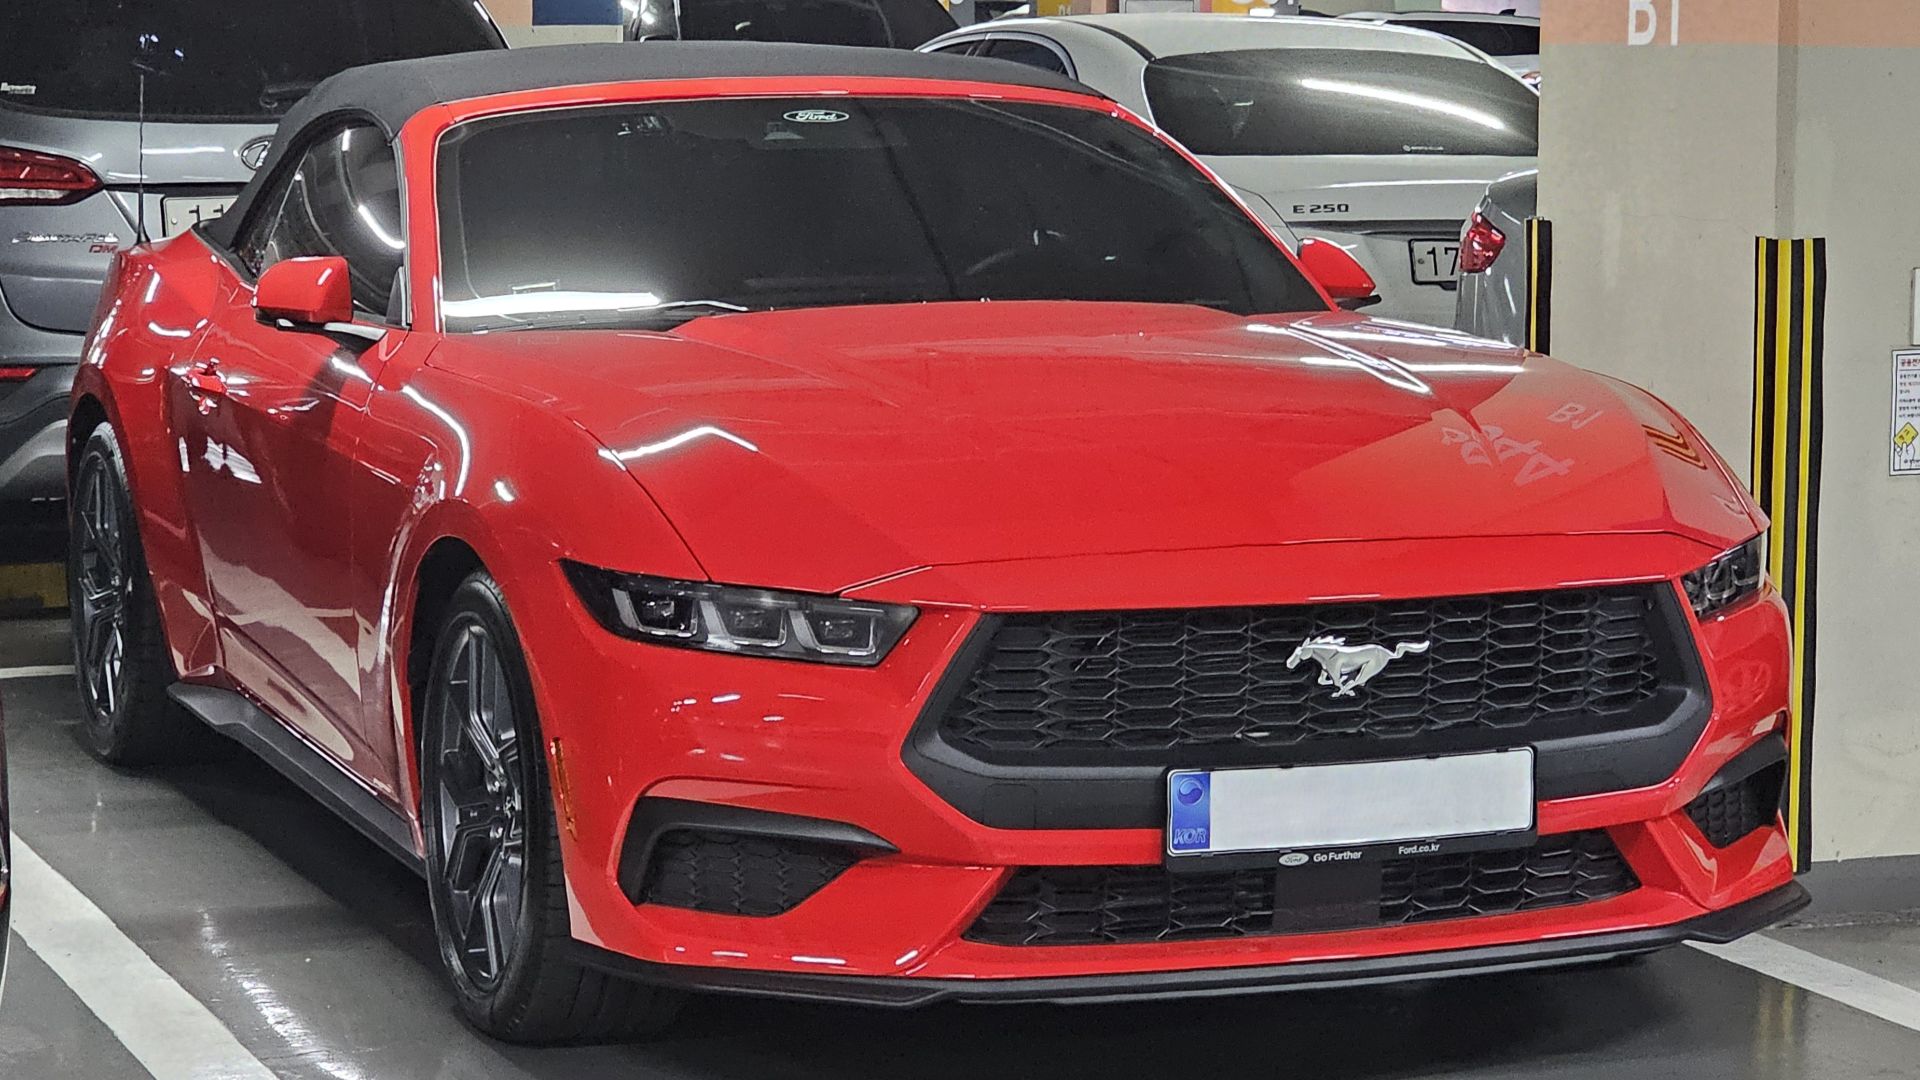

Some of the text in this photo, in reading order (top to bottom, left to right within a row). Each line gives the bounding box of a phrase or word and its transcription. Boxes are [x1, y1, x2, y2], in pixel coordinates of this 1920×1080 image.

[794, 110, 840, 122] Ford
[1292, 203, 1349, 214] E 250
[1426, 246, 1459, 276] 17
[1174, 827, 1206, 844] KOR
[1313, 853, 1327, 863] Go
[1328, 850, 1362, 861] Further
[1398, 843, 1440, 855] Ford.co.kr
